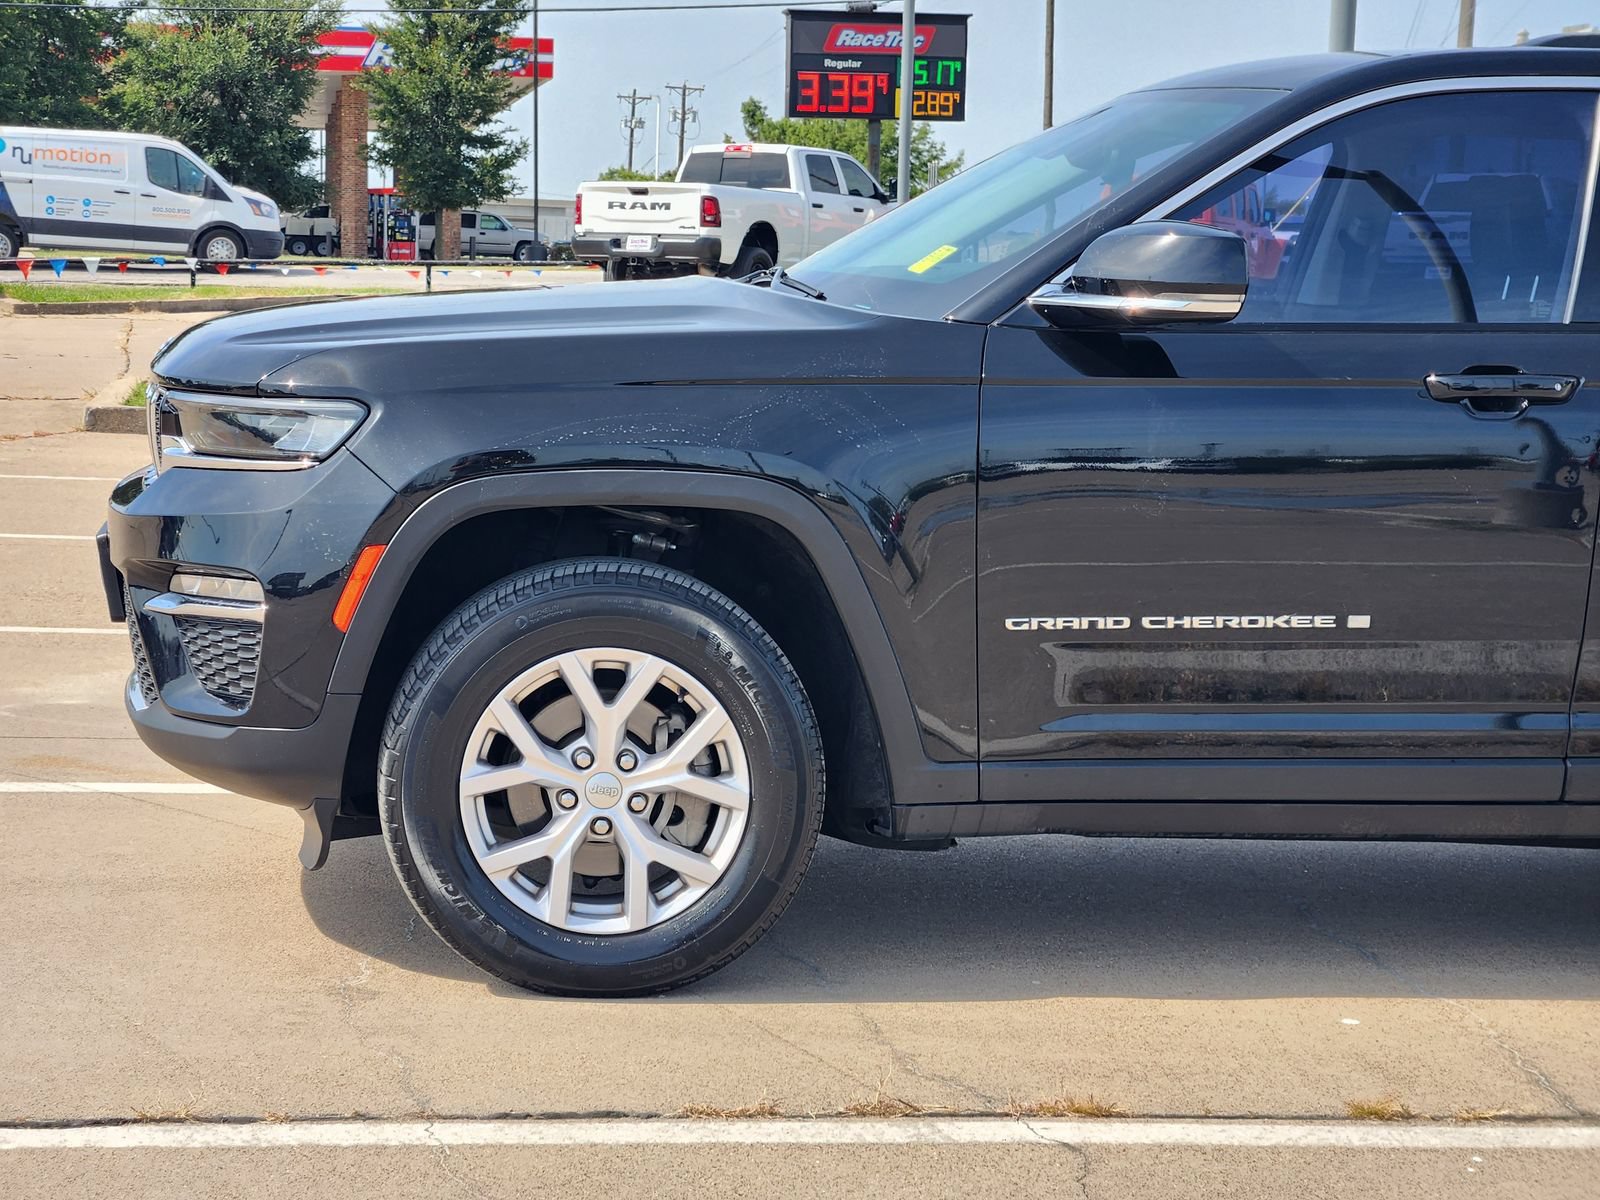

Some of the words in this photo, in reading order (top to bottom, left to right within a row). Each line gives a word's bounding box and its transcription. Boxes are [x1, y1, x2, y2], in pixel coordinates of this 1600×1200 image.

[835, 30, 925, 49] RaceTrc
[824, 59, 862, 69] Regular
[608, 201, 672, 211] RAM
[1005, 616, 1131, 630] GRAND
[1141, 614, 1337, 630] CHEROKEE
[590, 784, 619, 797] Jeep
